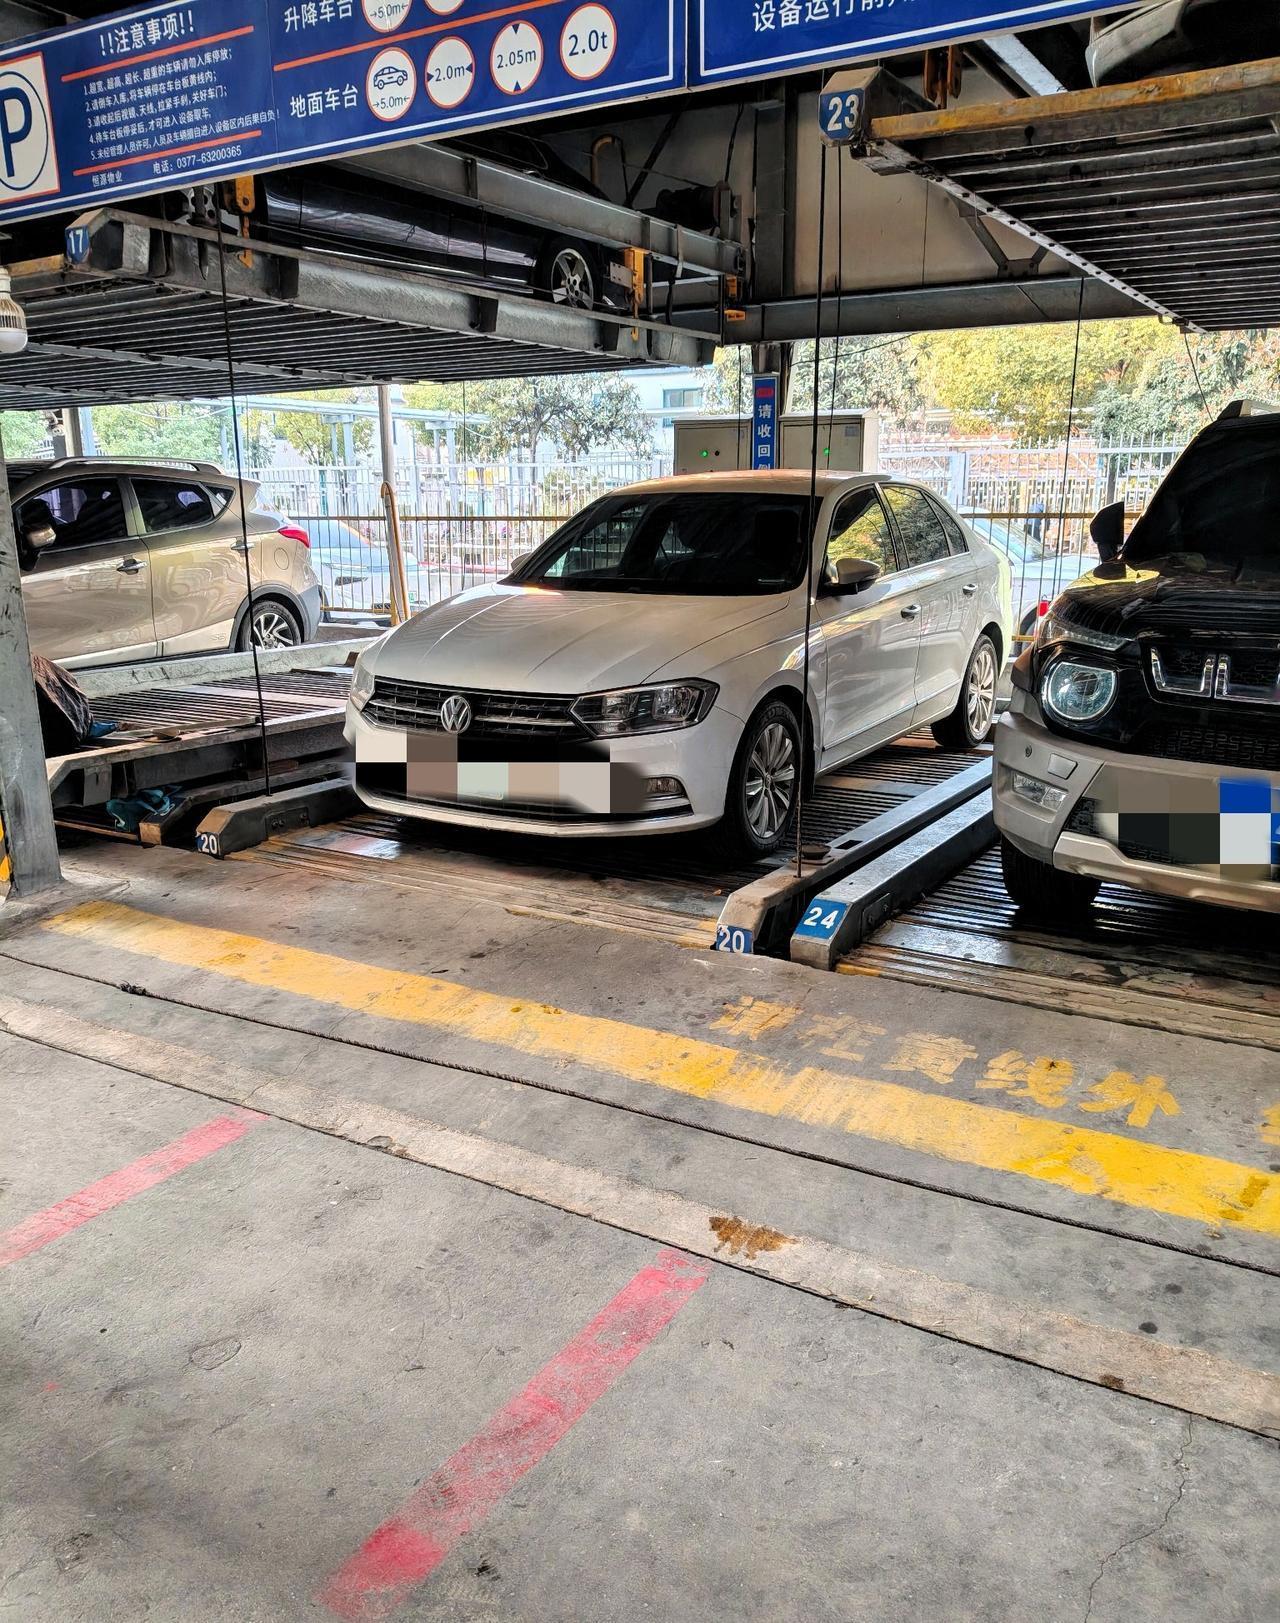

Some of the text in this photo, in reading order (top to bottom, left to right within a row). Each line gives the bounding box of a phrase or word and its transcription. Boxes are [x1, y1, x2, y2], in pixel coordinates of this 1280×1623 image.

[284, 0, 353, 33] 升降车台
[568, 29, 608, 57] 2.0t
[496, 49, 537, 69] 2.05m
[434, 65, 465, 82] 2.0m
[289, 83, 359, 119] 地面车台
[379, 95, 404, 110] 5.0m
[826, 93, 860, 132] 23
[0, 86, 33, 178] P
[92, 171, 123, 188] 恒源物业
[68, 229, 83, 254] 17
[200, 833, 218, 855] 20
[803, 906, 840, 929] 24
[717, 926, 745, 954] 20
